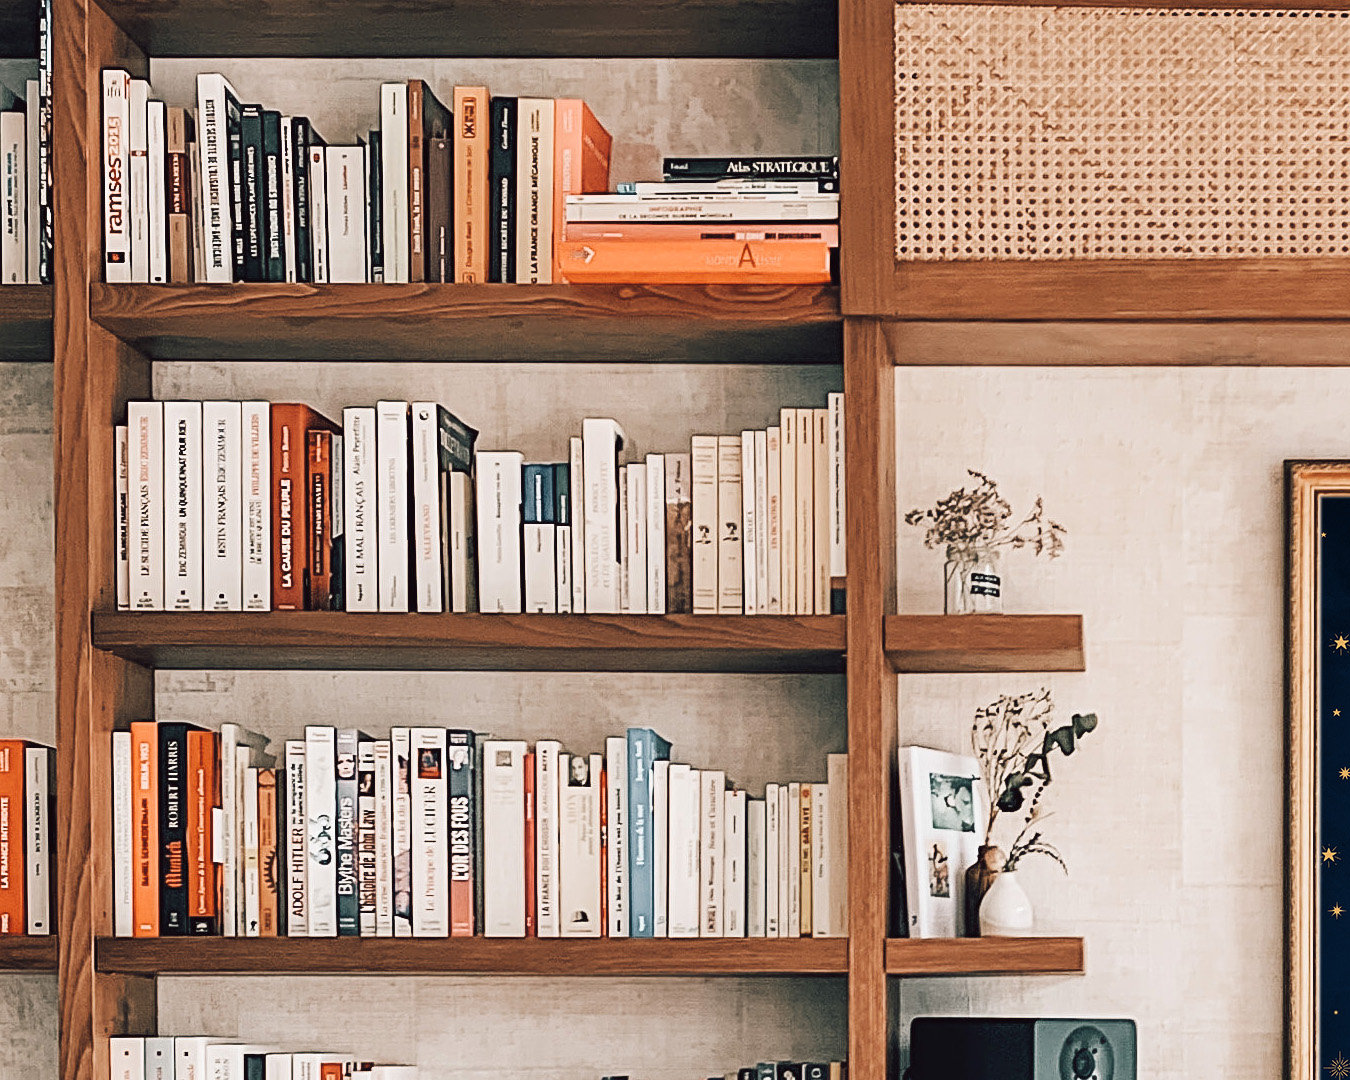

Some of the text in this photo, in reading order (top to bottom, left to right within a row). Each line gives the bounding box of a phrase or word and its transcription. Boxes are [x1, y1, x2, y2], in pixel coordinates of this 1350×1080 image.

[107, 115, 123, 235] ramses 2015
[531, 261, 538, 274] LA
[178, 437, 187, 456] POUR
[353, 455, 361, 475] Alain
[140, 484, 150, 527] FRANÇAIS
[178, 507, 187, 518] UN
[217, 485, 227, 526] FRANÇAIS
[140, 528, 150, 564] SUICIDE
[217, 527, 227, 558] DESTIN
[281, 479, 292, 588] LA CAUSE DU PEUPLE
[355, 480, 366, 575] LE MAL FRANÇAIS
[140, 565, 150, 576] LE
[164, 740, 182, 889] Munich ROBERT HARRIS
[423, 785, 437, 844] LUCIFER
[1, 797, 9, 889] LA FRANCE INTERDITE
[338, 797, 354, 895] Blythe Masters
[360, 833, 375, 854] John
[451, 796, 469, 880] L'OR DES FOUS
[292, 828, 304, 917] ADOLF HITLER
[360, 857, 375, 869] de
[360, 872, 375, 914] L'histoire
[542, 875, 550, 917] LA FRANCE
